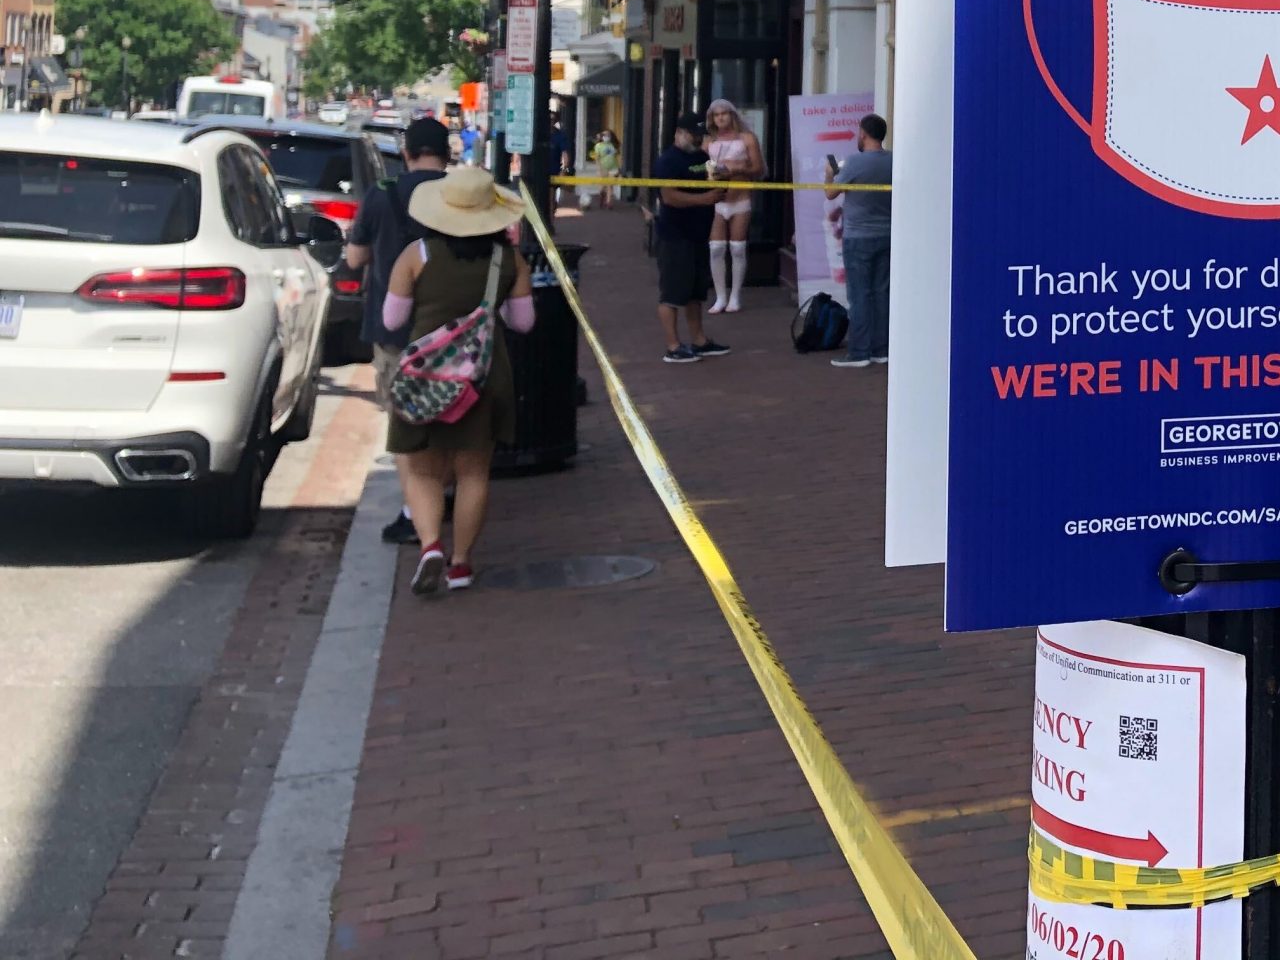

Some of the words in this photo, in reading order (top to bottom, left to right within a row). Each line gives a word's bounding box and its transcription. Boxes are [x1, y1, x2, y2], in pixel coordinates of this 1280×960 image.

[803, 106, 827, 117] take
[830, 106, 837, 115] a
[827, 118, 861, 129] detou
[1008, 263, 1118, 295] Thank
[1132, 269, 1190, 299] you
[1203, 259, 1248, 289] for
[1003, 310, 1037, 337] to
[1052, 304, 1173, 343] protect
[1140, 359, 1178, 391] IN
[1161, 456, 1217, 467] BUSINESS
[1077, 662, 1144, 683] Communication
[1146, 673, 1156, 684] at
[1158, 673, 1176, 685] 311
[1179, 676, 1191, 685] or
[1032, 902, 1125, 960] 06/02/20
